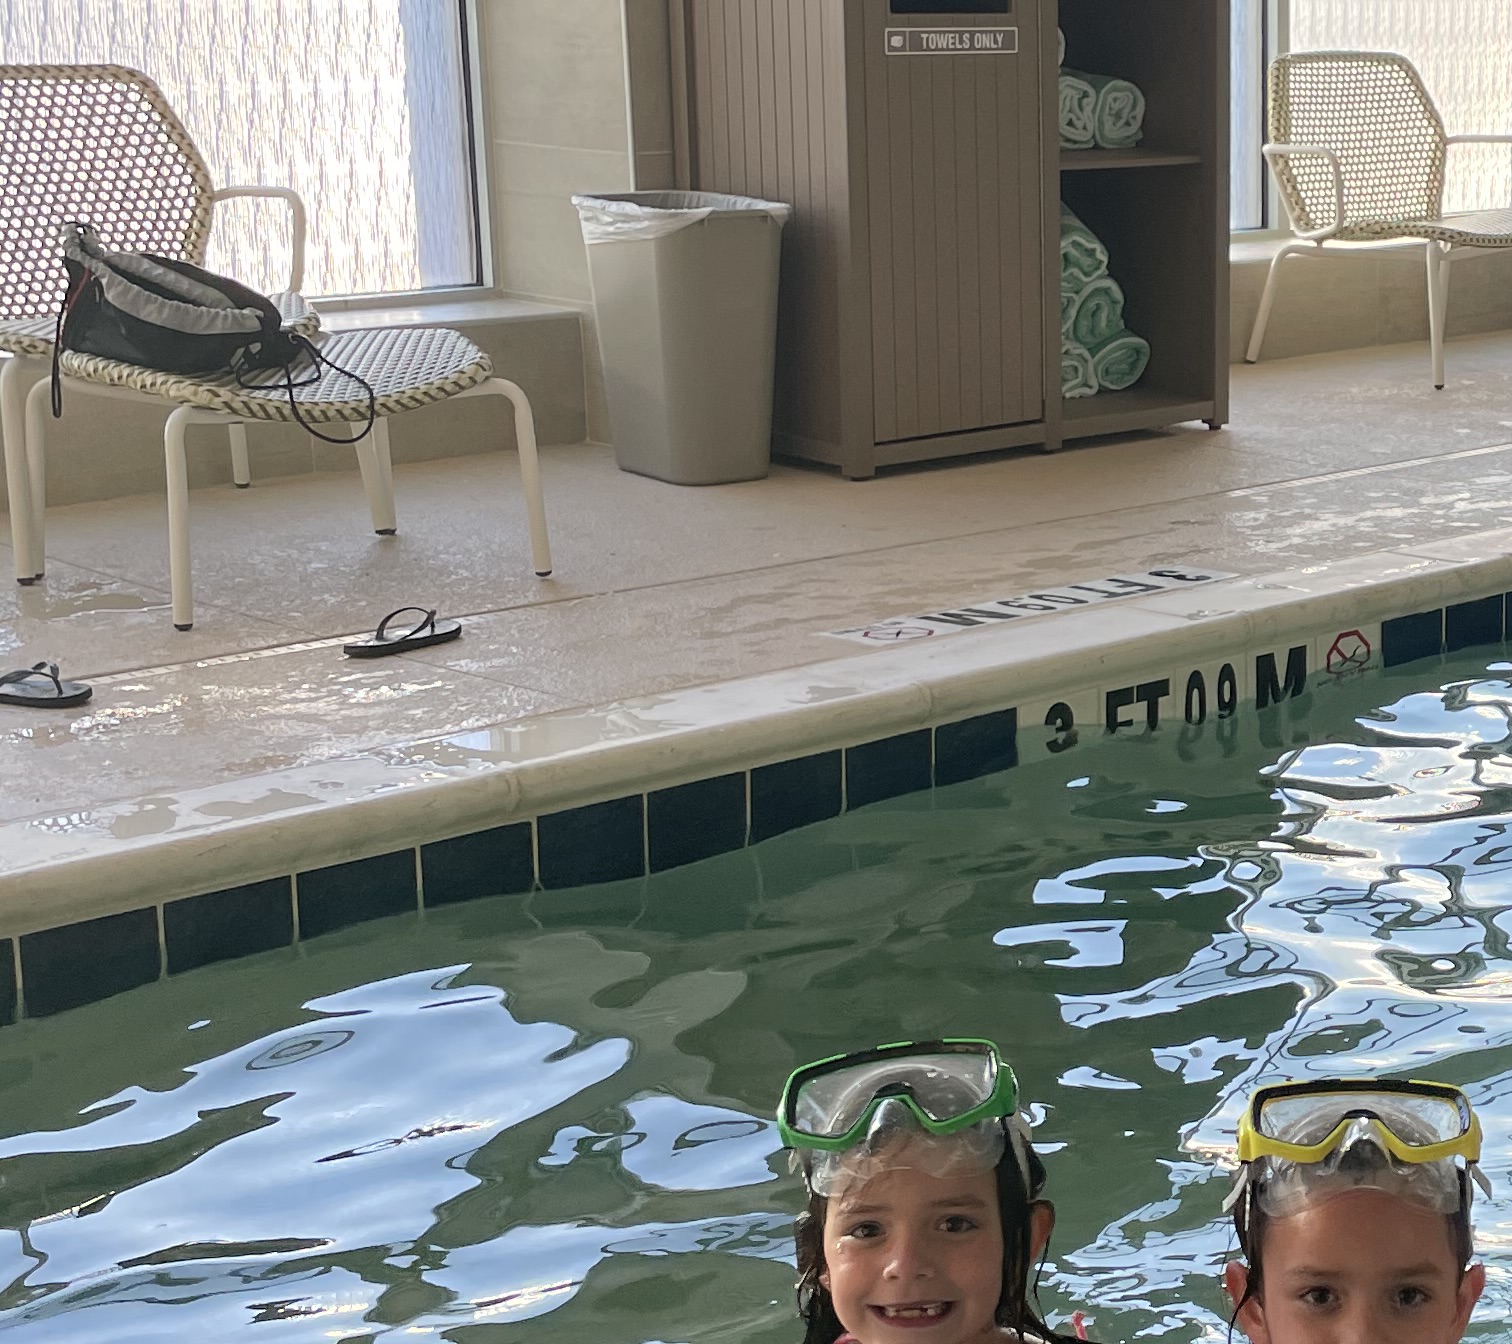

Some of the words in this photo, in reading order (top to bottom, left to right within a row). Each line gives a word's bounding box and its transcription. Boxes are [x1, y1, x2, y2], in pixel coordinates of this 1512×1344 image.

[920, 33, 970, 50] TOWELS
[974, 32, 1004, 49] ONLY
[1147, 569, 1211, 582] 3
[1072, 578, 1163, 599] FT
[918, 607, 1021, 627] M
[1044, 701, 1079, 753] 3
[1105, 678, 1170, 735] FT
[1255, 644, 1308, 711] M
